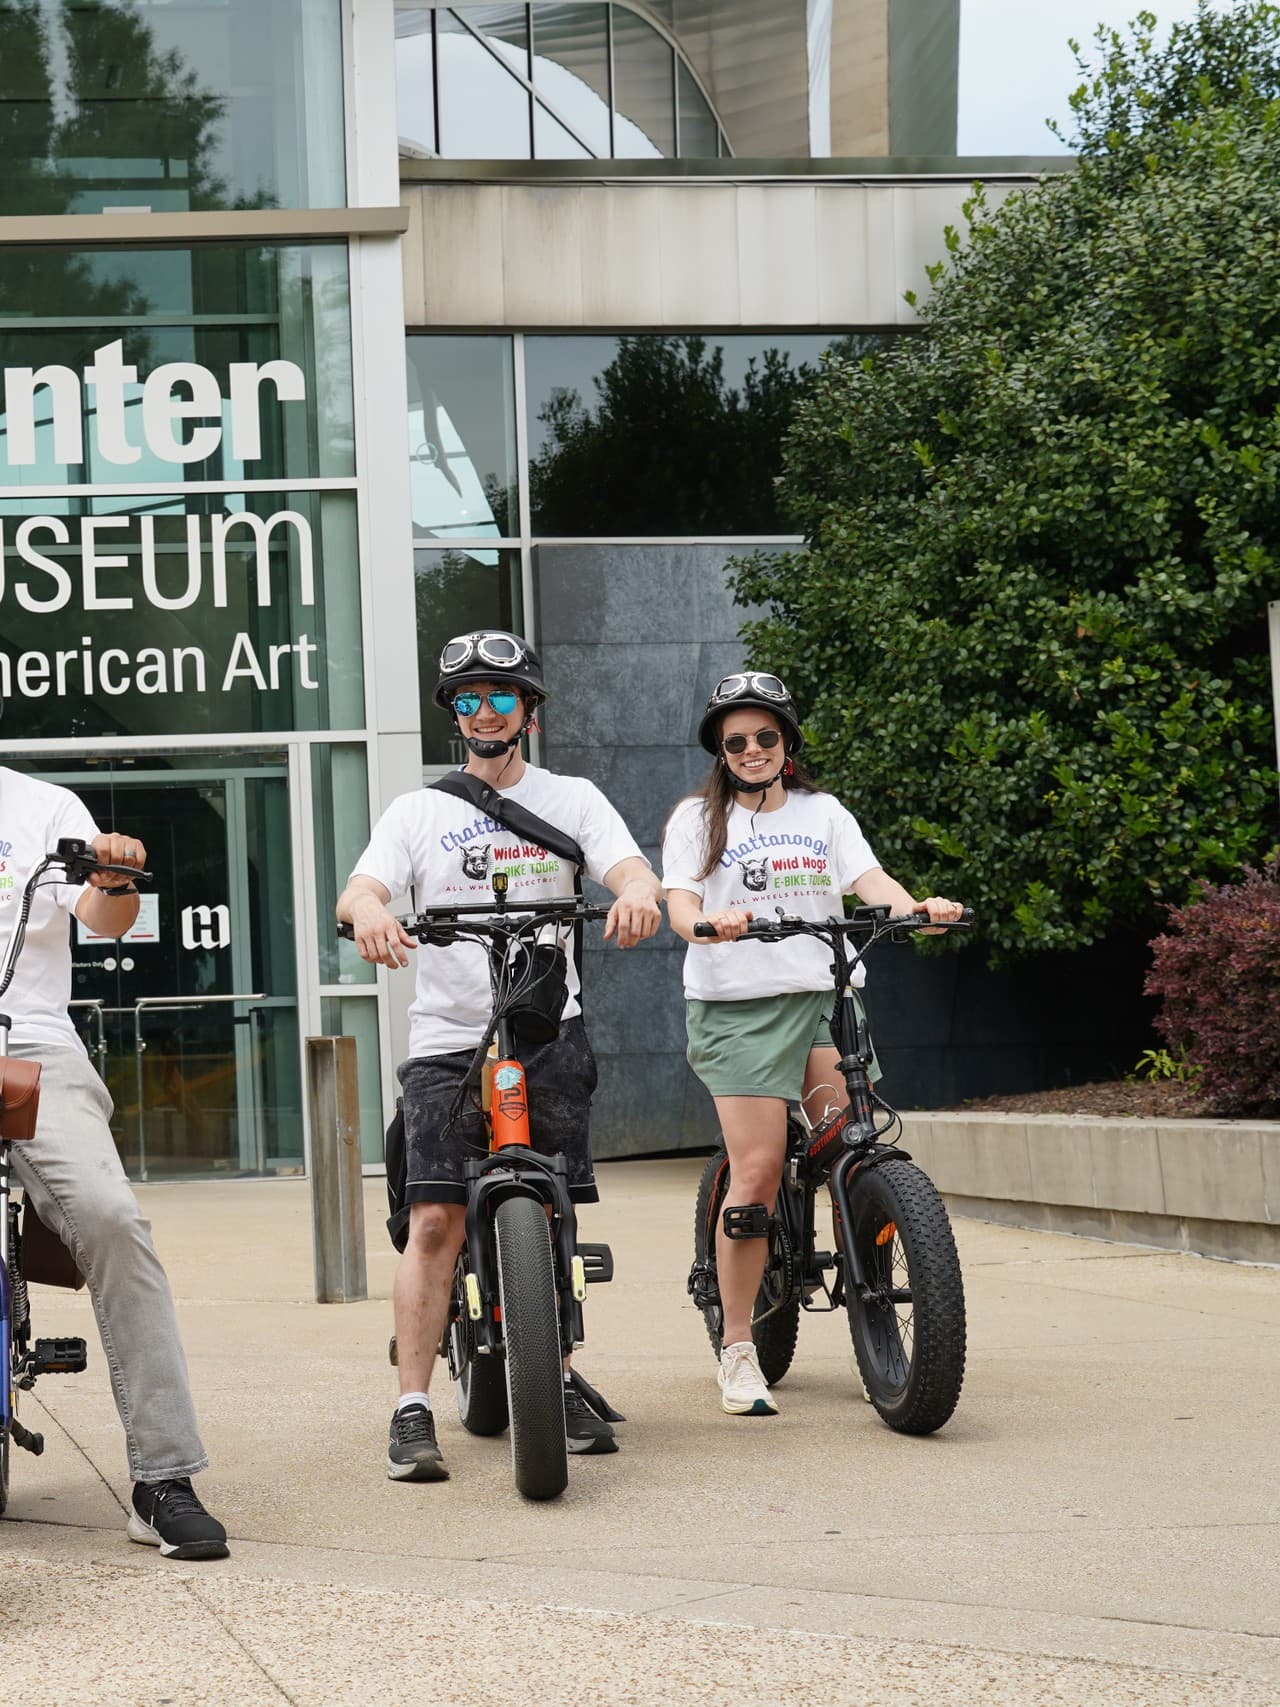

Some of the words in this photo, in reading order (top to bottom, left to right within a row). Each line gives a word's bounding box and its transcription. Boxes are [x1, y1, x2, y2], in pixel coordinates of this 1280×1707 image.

[221, 631, 319, 692] Art
[493, 845, 520, 861] Wild
[522, 845, 548, 861] Hog
[530, 861, 559, 874] TOURS
[771, 856, 799, 872] Wild
[802, 856, 827, 874] Hogs
[774, 875, 806, 888] E-BIKE
